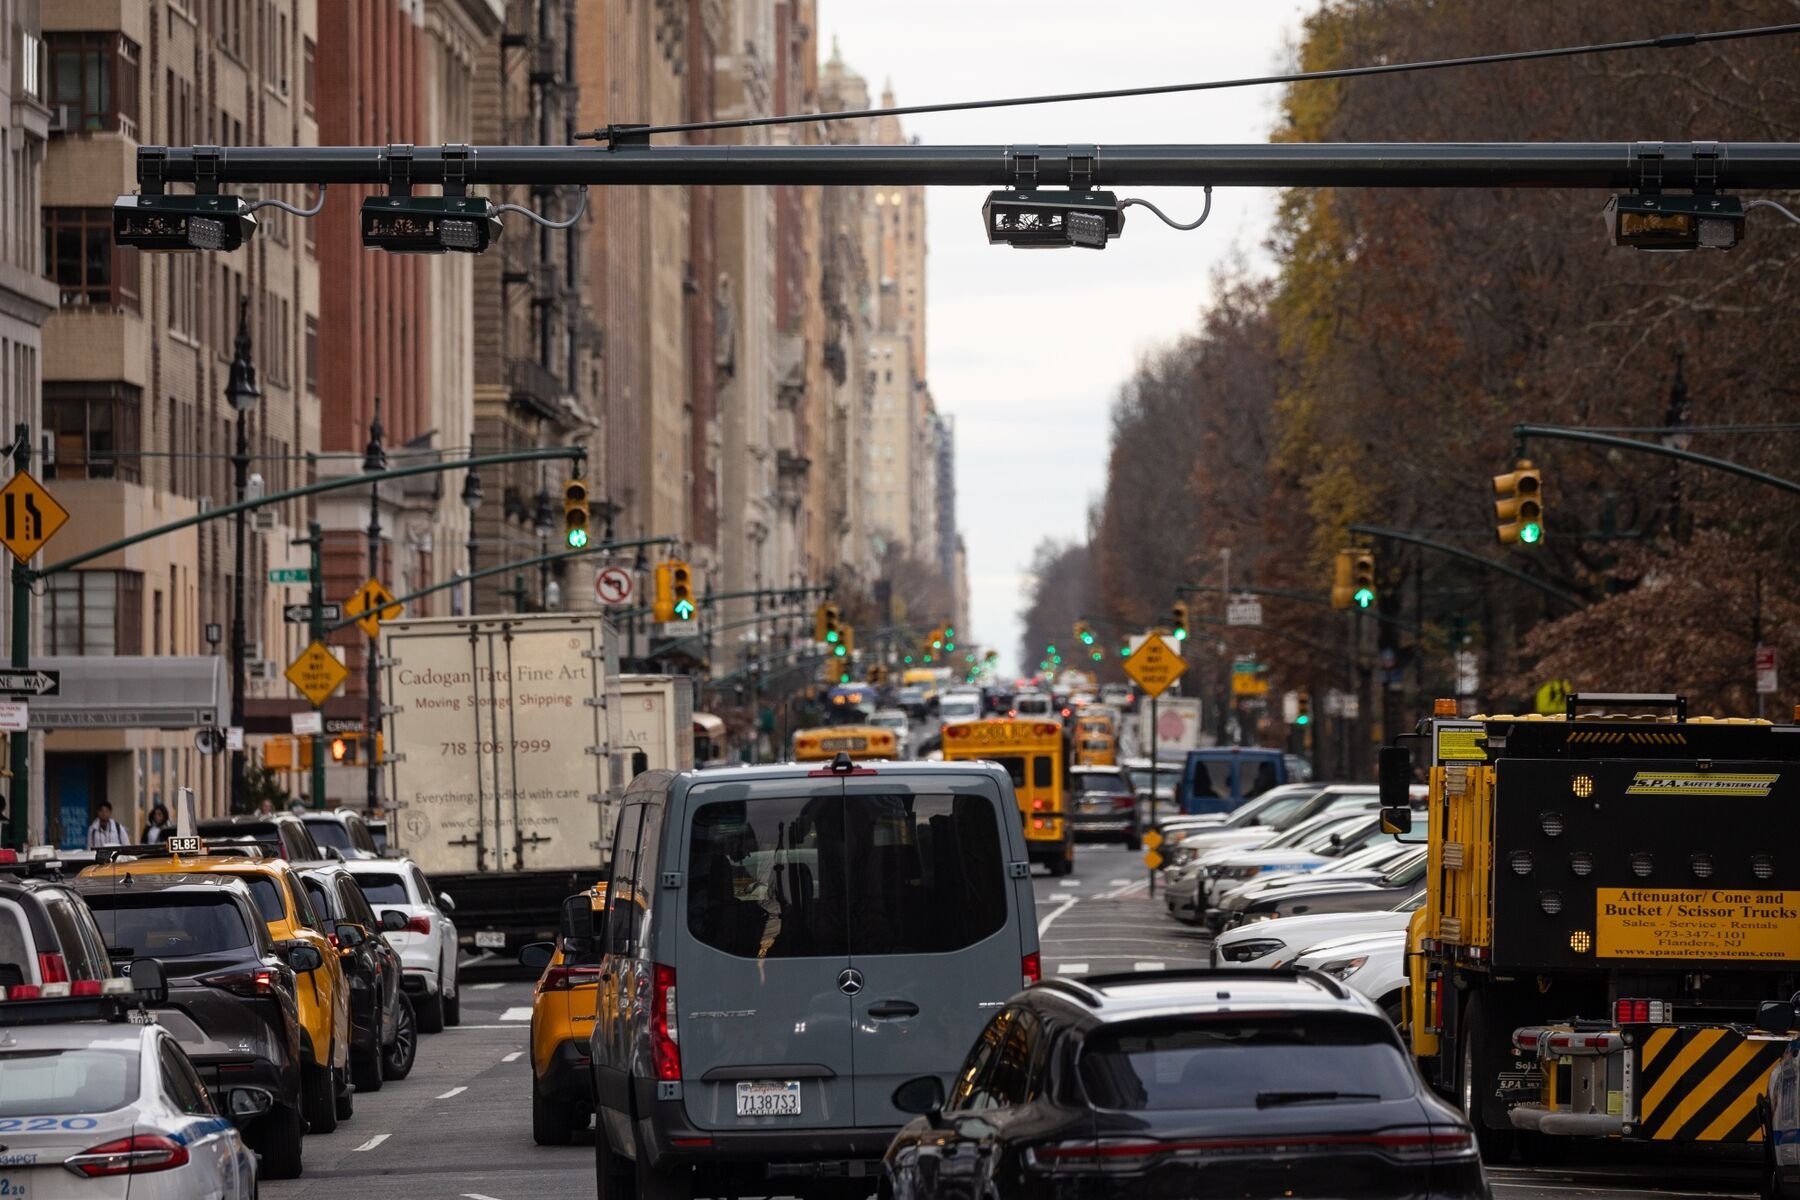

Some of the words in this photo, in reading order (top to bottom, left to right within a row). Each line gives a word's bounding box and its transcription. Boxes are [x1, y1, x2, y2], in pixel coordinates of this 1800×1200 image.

[398, 668, 471, 687] Cadogan
[517, 665, 553, 682] Fine
[558, 664, 587, 680] Art
[23, 678, 48, 688] WAY
[415, 696, 461, 711] Moving
[519, 692, 573, 708] Shipping
[59, 712, 97, 724] PARK
[102, 712, 143, 724] WEST
[626, 728, 647, 742] Art
[440, 742, 467, 756] 718
[1636, 779, 1680, 788] S.P.A.
[1682, 780, 1715, 788] SAFETY
[1715, 781, 1751, 789] SYSTEMS
[415, 791, 478, 805] Everything,
[529, 788, 553, 800] with
[556, 789, 579, 799] care
[172, 838, 196, 850] 5L82
[1619, 890, 1708, 904] Attenuator/
[1712, 891, 1751, 904] Cone
[1755, 892, 1784, 904] and
[1605, 904, 1662, 917] Bucket
[1677, 905, 1735, 918] Scissor
[1740, 906, 1797, 919] Trucks
[1622, 919, 1656, 928] Sales
[1669, 920, 1717, 929] Service
[1731, 921, 1778, 929] Rentals
[1654, 930, 1746, 939] 973-347-1101
[1658, 938, 1719, 948] Flanders,
[1615, 948, 1785, 958] www.spasafetysystems.com
[0, 1153, 38, 1165] 34PCT
